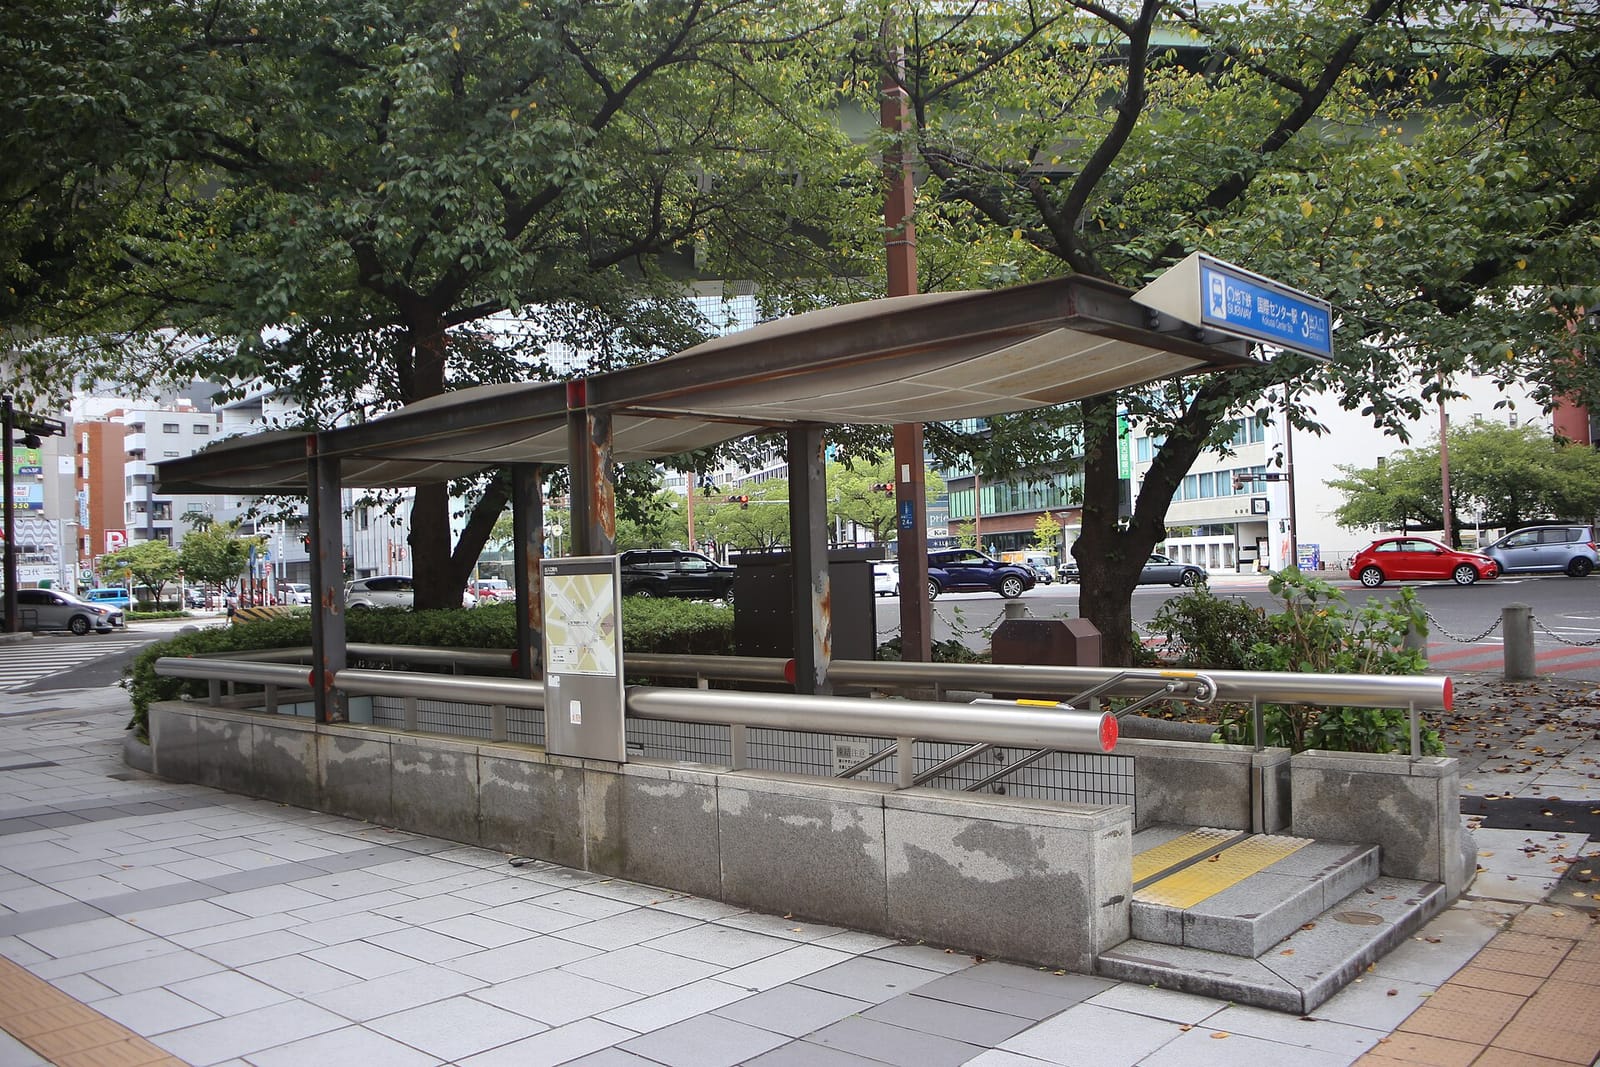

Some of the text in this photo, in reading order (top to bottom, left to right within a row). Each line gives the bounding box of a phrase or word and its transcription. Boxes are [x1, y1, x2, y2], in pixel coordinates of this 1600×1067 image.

[1234, 288, 1252, 308] 地下鉄
[1227, 302, 1253, 320] SUBWAY
[1257, 296, 1298, 325] 国際センター駅
[1301, 311, 1310, 338] 3
[1309, 313, 1325, 333] 出入口
[106, 531, 124, 554] P
